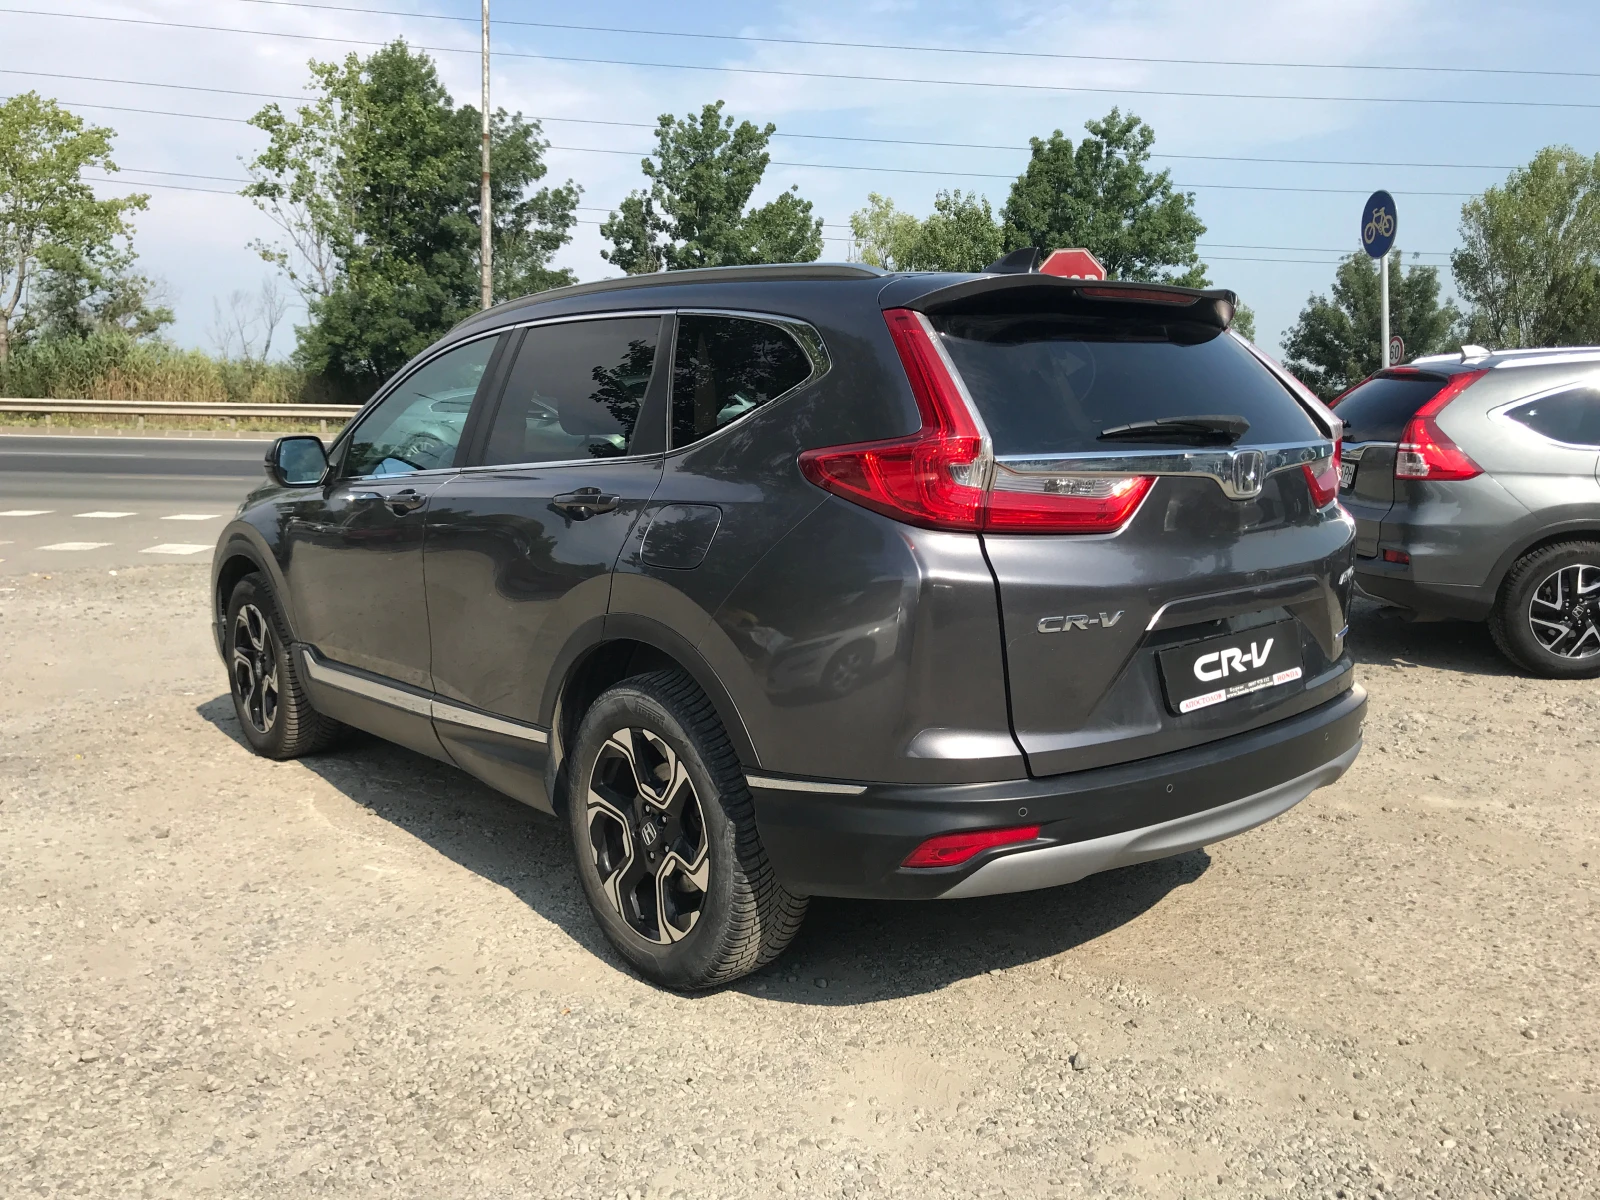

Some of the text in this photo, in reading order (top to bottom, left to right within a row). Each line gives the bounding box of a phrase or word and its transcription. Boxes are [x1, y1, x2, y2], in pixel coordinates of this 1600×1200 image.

[1389, 345, 1399, 360] 60
[1037, 610, 1125, 634] CR-V
[1193, 638, 1274, 682] CR-V
[1277, 670, 1299, 682] HONDA
